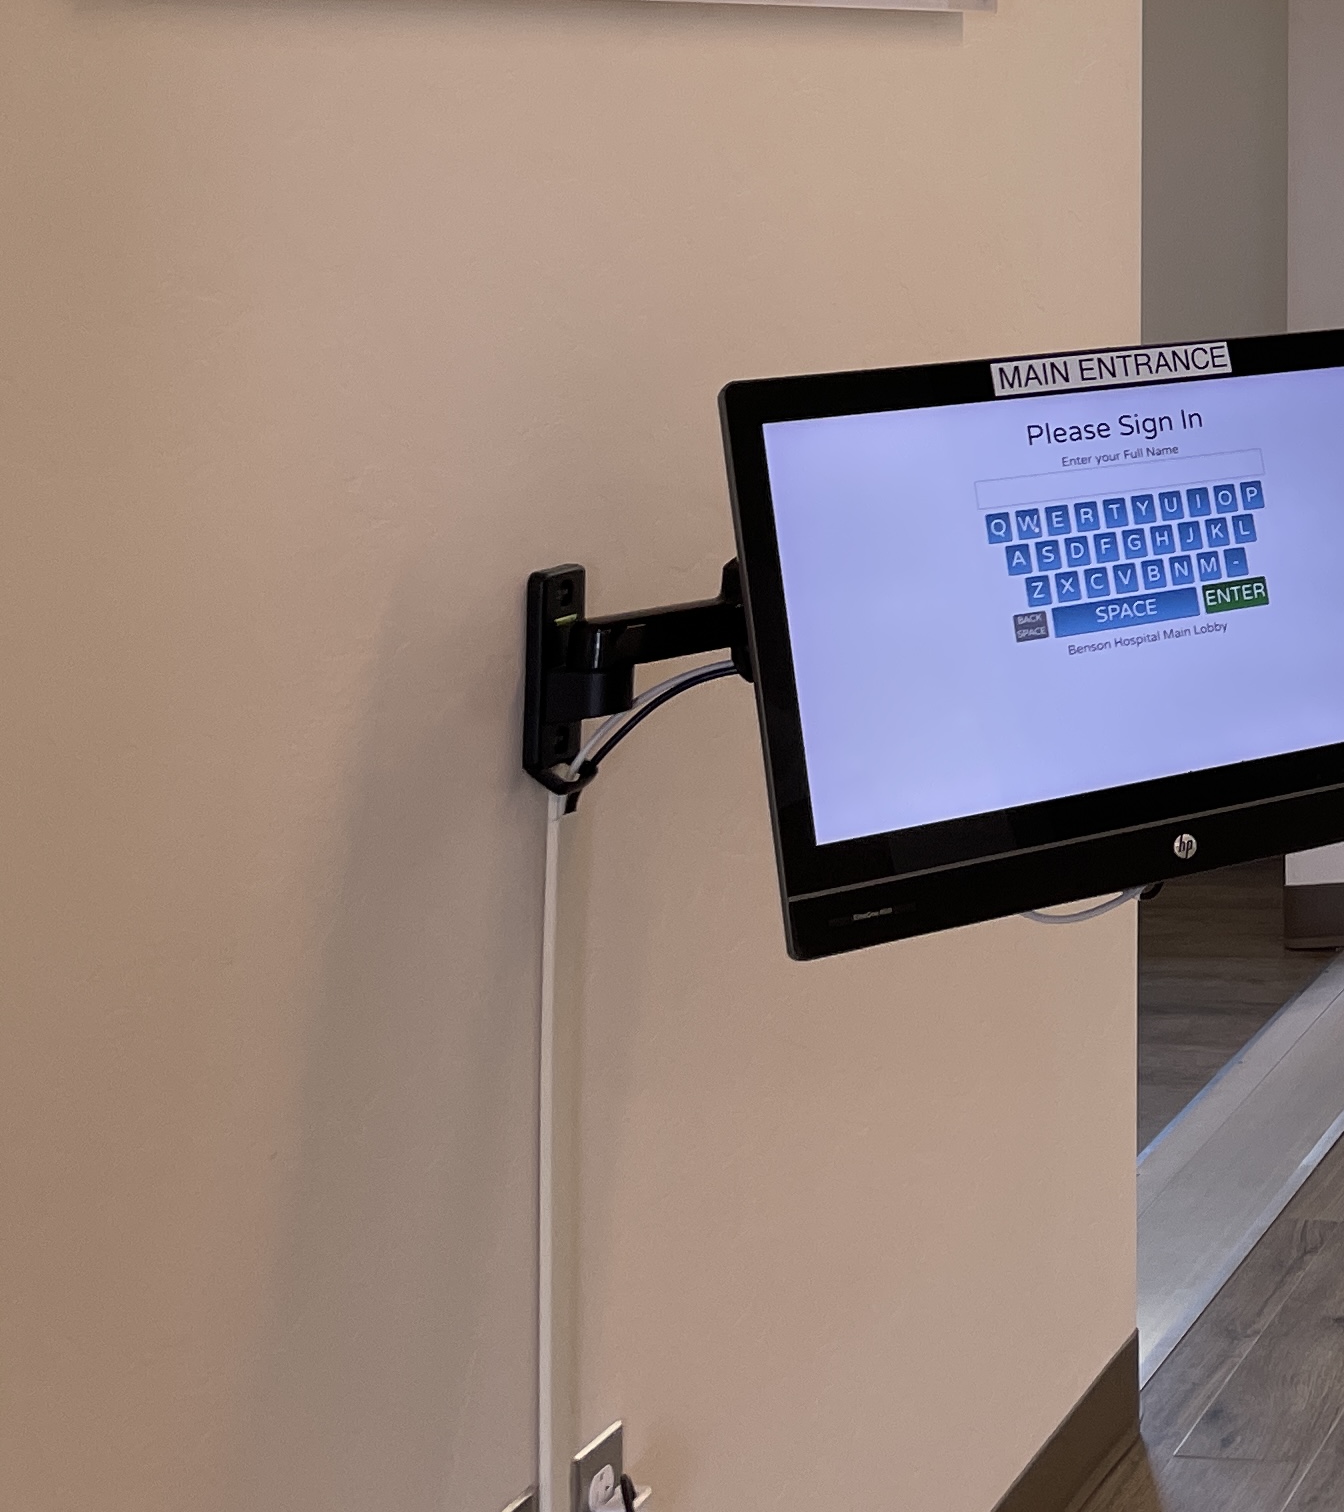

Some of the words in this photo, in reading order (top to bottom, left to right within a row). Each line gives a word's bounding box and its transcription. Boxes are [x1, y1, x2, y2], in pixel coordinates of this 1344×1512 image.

[999, 361, 1070, 390] MAIN
[1079, 345, 1229, 382] ENTRANCE
[1027, 422, 1111, 445] Please
[1118, 413, 1173, 439] Sign
[1181, 409, 1203, 430] In
[1061, 455, 1092, 467] Enter
[1095, 453, 1120, 465] your
[1123, 448, 1144, 460] Full
[1146, 444, 1179, 457] Name
[990, 518, 1006, 538] Q
[1053, 511, 1064, 528] E
[1080, 508, 1094, 524] R
[1108, 504, 1121, 520] T
[1136, 500, 1149, 516] Y
[1164, 496, 1178, 513] U
[1218, 490, 1232, 506] O
[1246, 487, 1258, 503] P
[1011, 551, 1026, 567] A
[1042, 546, 1054, 563] S
[1071, 542, 1084, 559] D
[1100, 538, 1112, 554] F
[1128, 534, 1142, 551] G
[1156, 530, 1170, 546] H
[1211, 523, 1224, 539] K
[1239, 520, 1250, 536] L
[1031, 582, 1045, 599] Z
[1061, 578, 1075, 594] X
[1090, 574, 1103, 590] C
[1118, 569, 1131, 585] V
[1150, 565, 1161, 581] B
[1174, 561, 1189, 578] N
[1201, 558, 1217, 574] M
[1205, 582, 1266, 607] ENTER
[1017, 613, 1042, 625] BACK
[1095, 599, 1158, 623] SPACE
[1016, 626, 1047, 638] SPACE
[1068, 640, 1111, 655] Benson
[1114, 631, 1160, 650] Hospital
[1163, 628, 1191, 639] Main
[1194, 621, 1228, 636] Lobby
[1176, 834, 1195, 859] hp
